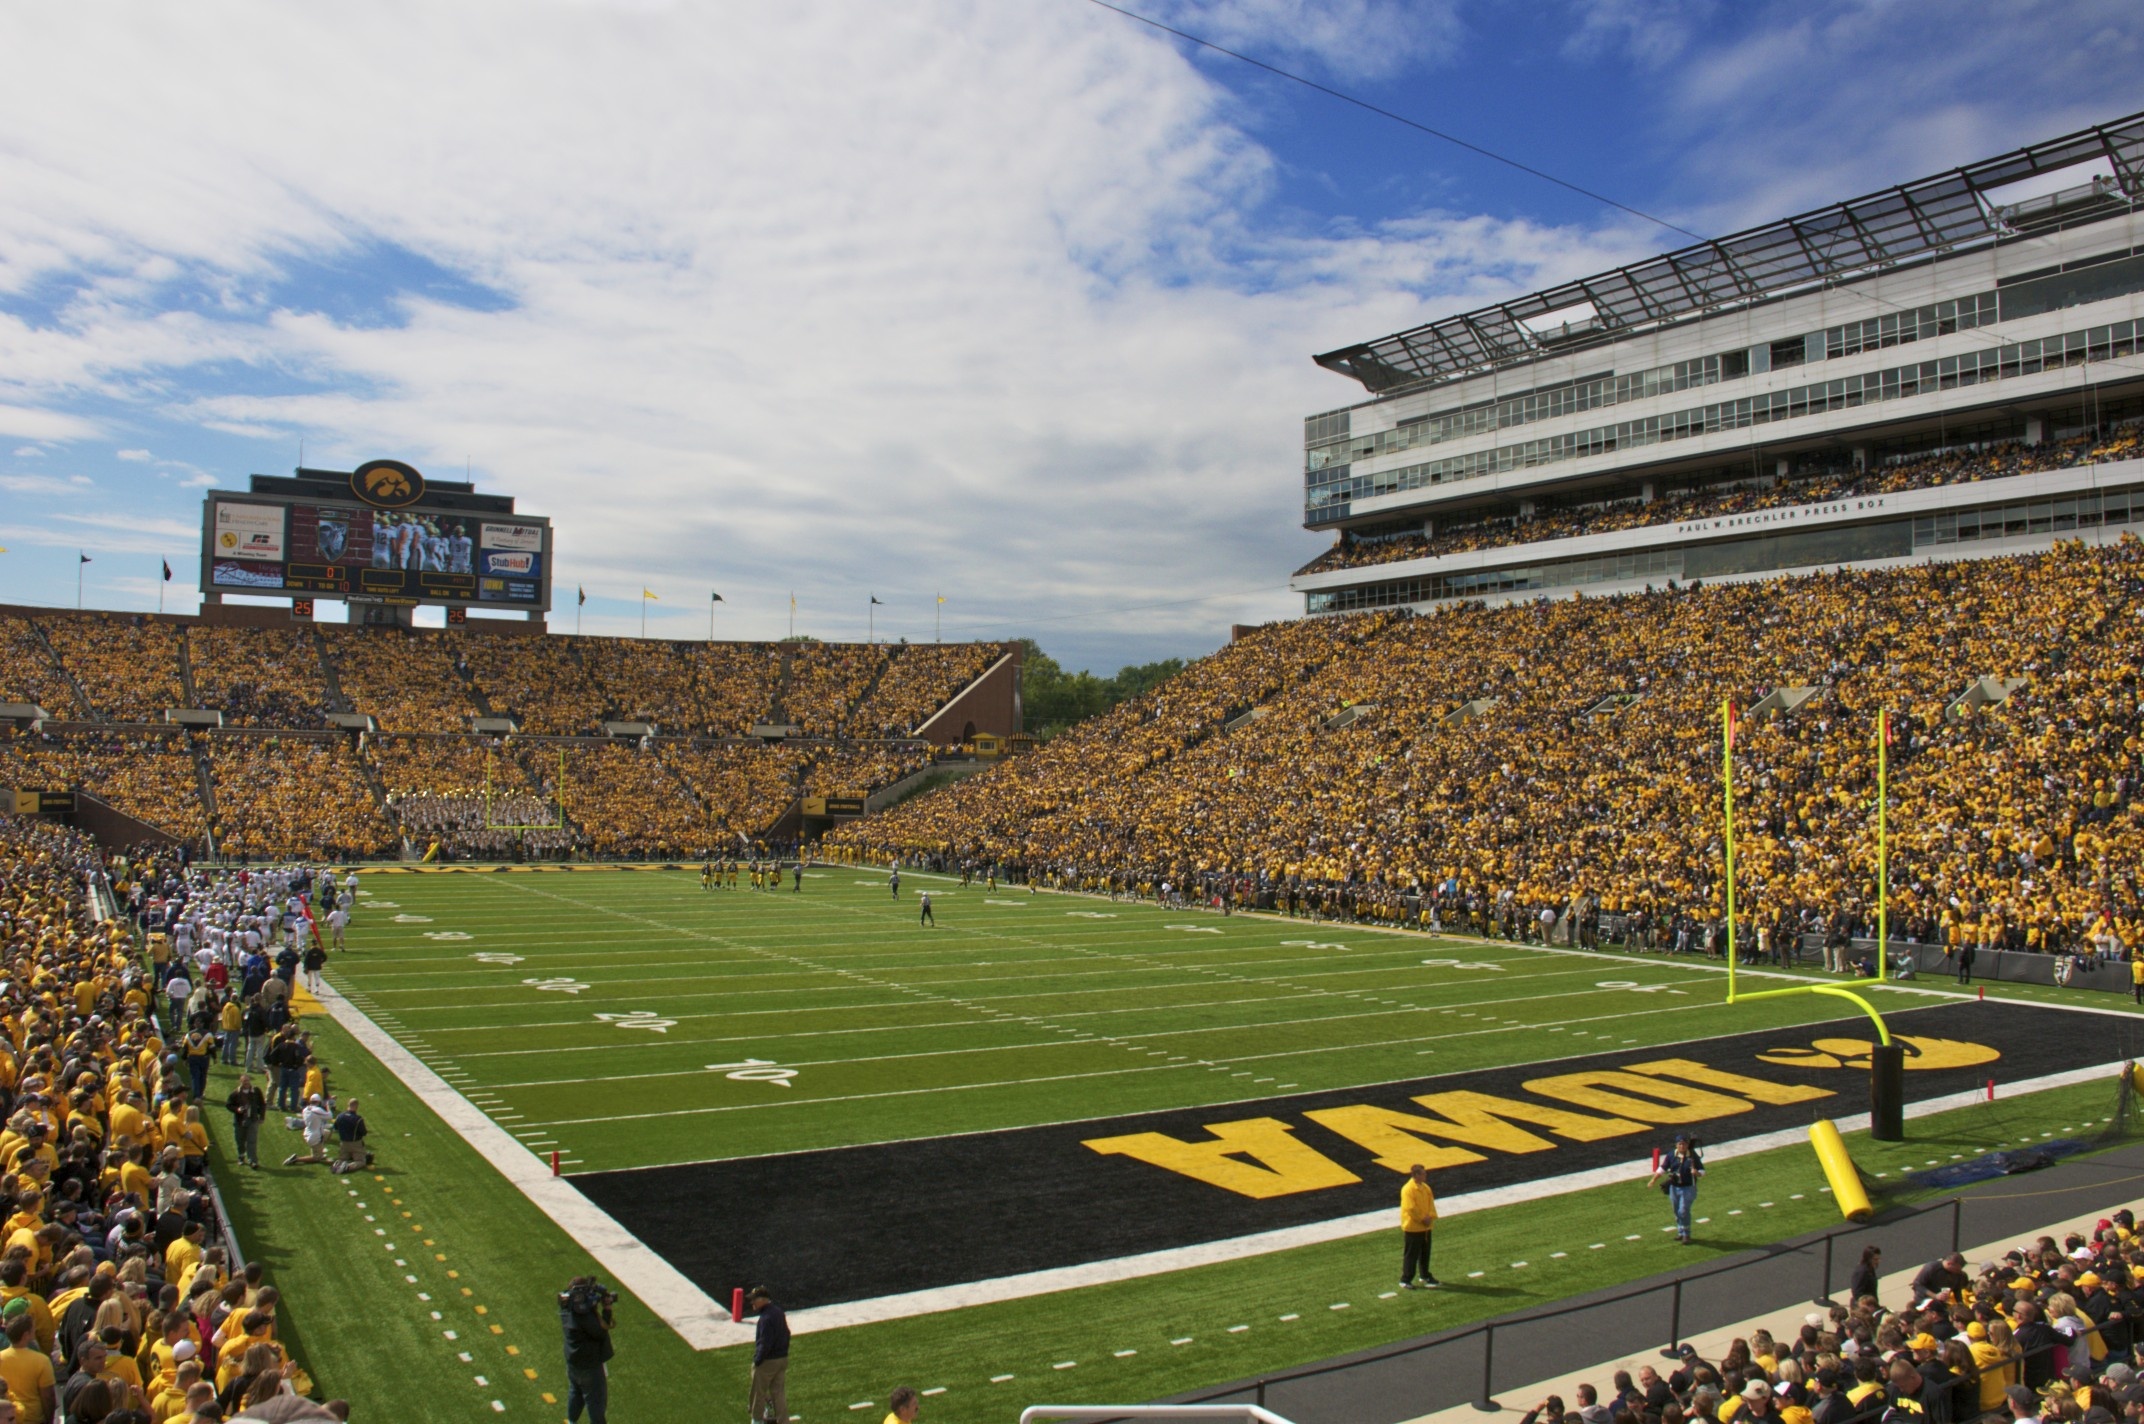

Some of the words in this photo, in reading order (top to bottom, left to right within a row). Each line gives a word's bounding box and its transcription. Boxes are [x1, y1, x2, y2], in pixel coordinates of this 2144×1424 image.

[1679, 522, 1709, 533] PAUL
[1714, 520, 1725, 529] W.
[1729, 511, 1796, 527] BRECHLER
[1805, 504, 1848, 517] PRESS
[1858, 499, 1885, 510] BOX
[376, 533, 387, 545] 12
[492, 557, 530, 569] StubHub!
[327, 567, 334, 578] 0
[339, 581, 350, 592] 10
[294, 602, 311, 615] 25
[449, 610, 464, 623] 25
[593, 1010, 678, 1029] 20
[704, 1058, 799, 1081] 10
[1082, 1058, 1836, 1200] IOWA
